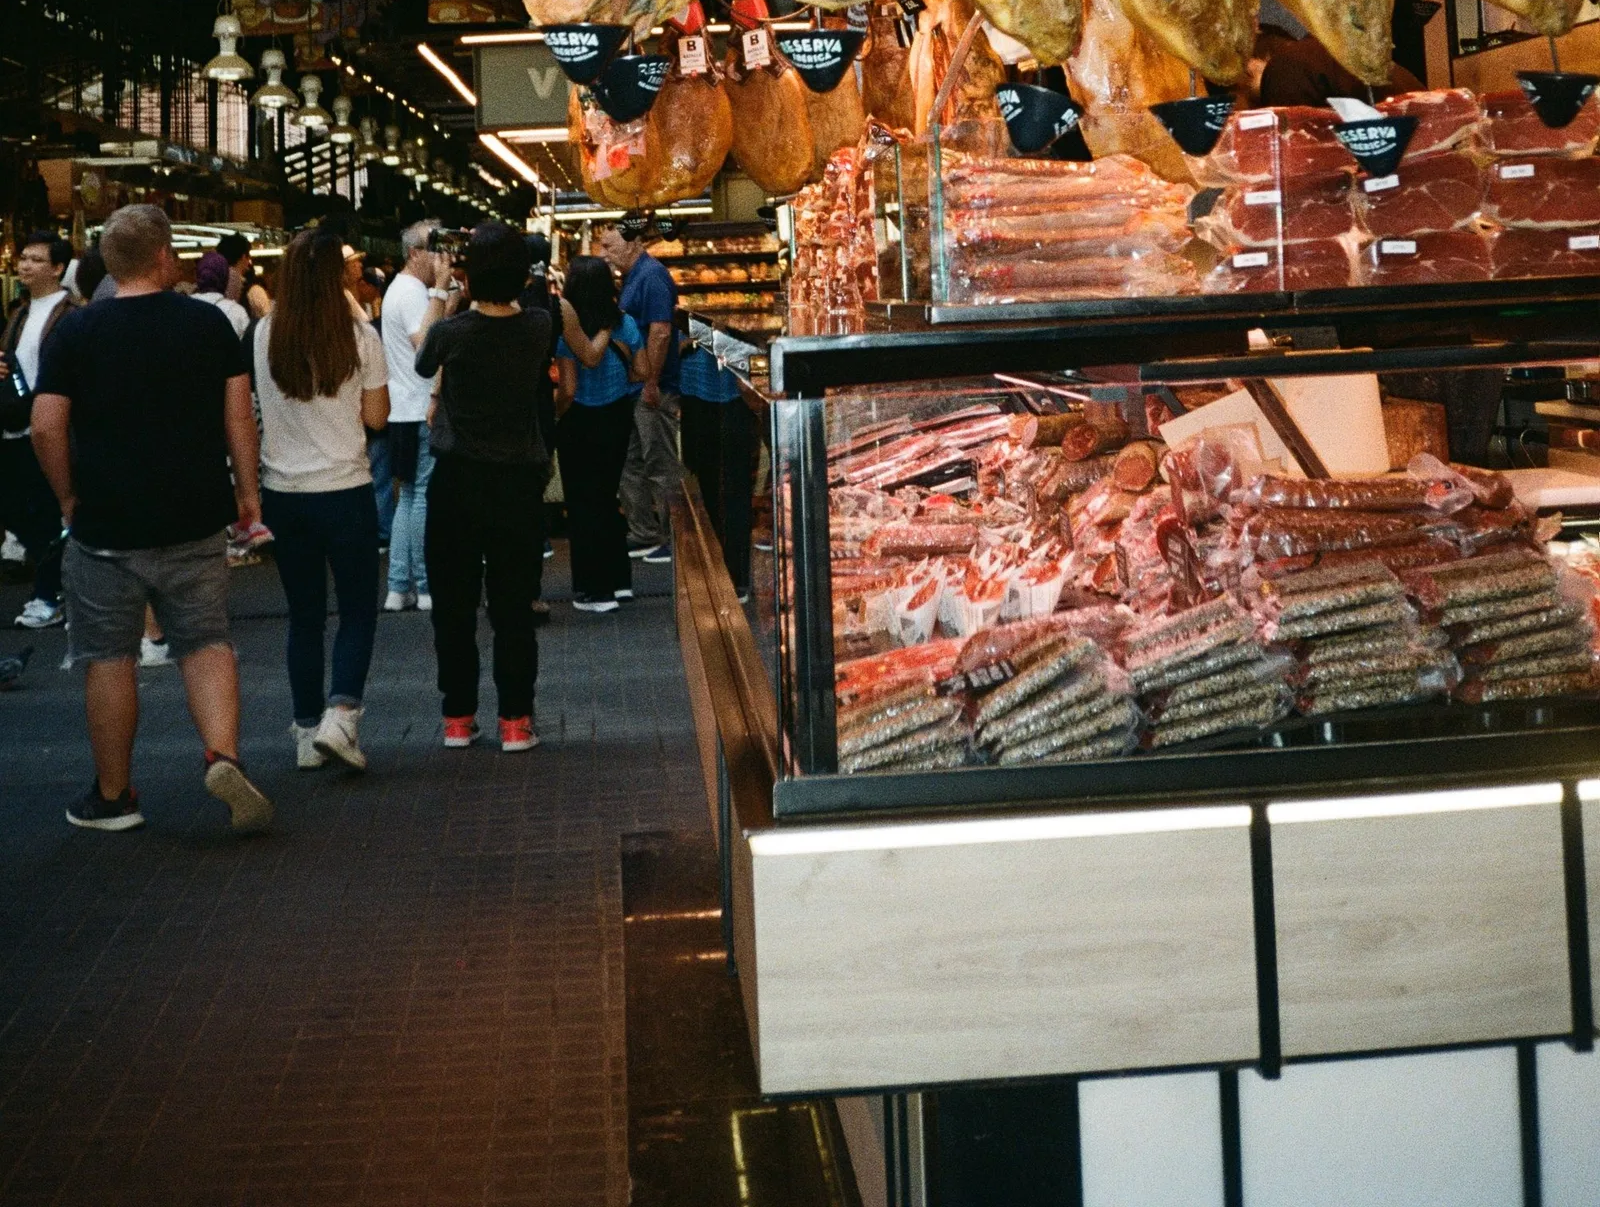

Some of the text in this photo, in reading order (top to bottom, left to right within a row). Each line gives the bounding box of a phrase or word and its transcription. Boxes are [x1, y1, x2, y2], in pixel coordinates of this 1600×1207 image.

[544, 32, 599, 46] ESERVA
[686, 40, 696, 51] B
[750, 34, 759, 45] B
[780, 38, 842, 53] ESERVA
[1337, 126, 1396, 143] ESERVA
